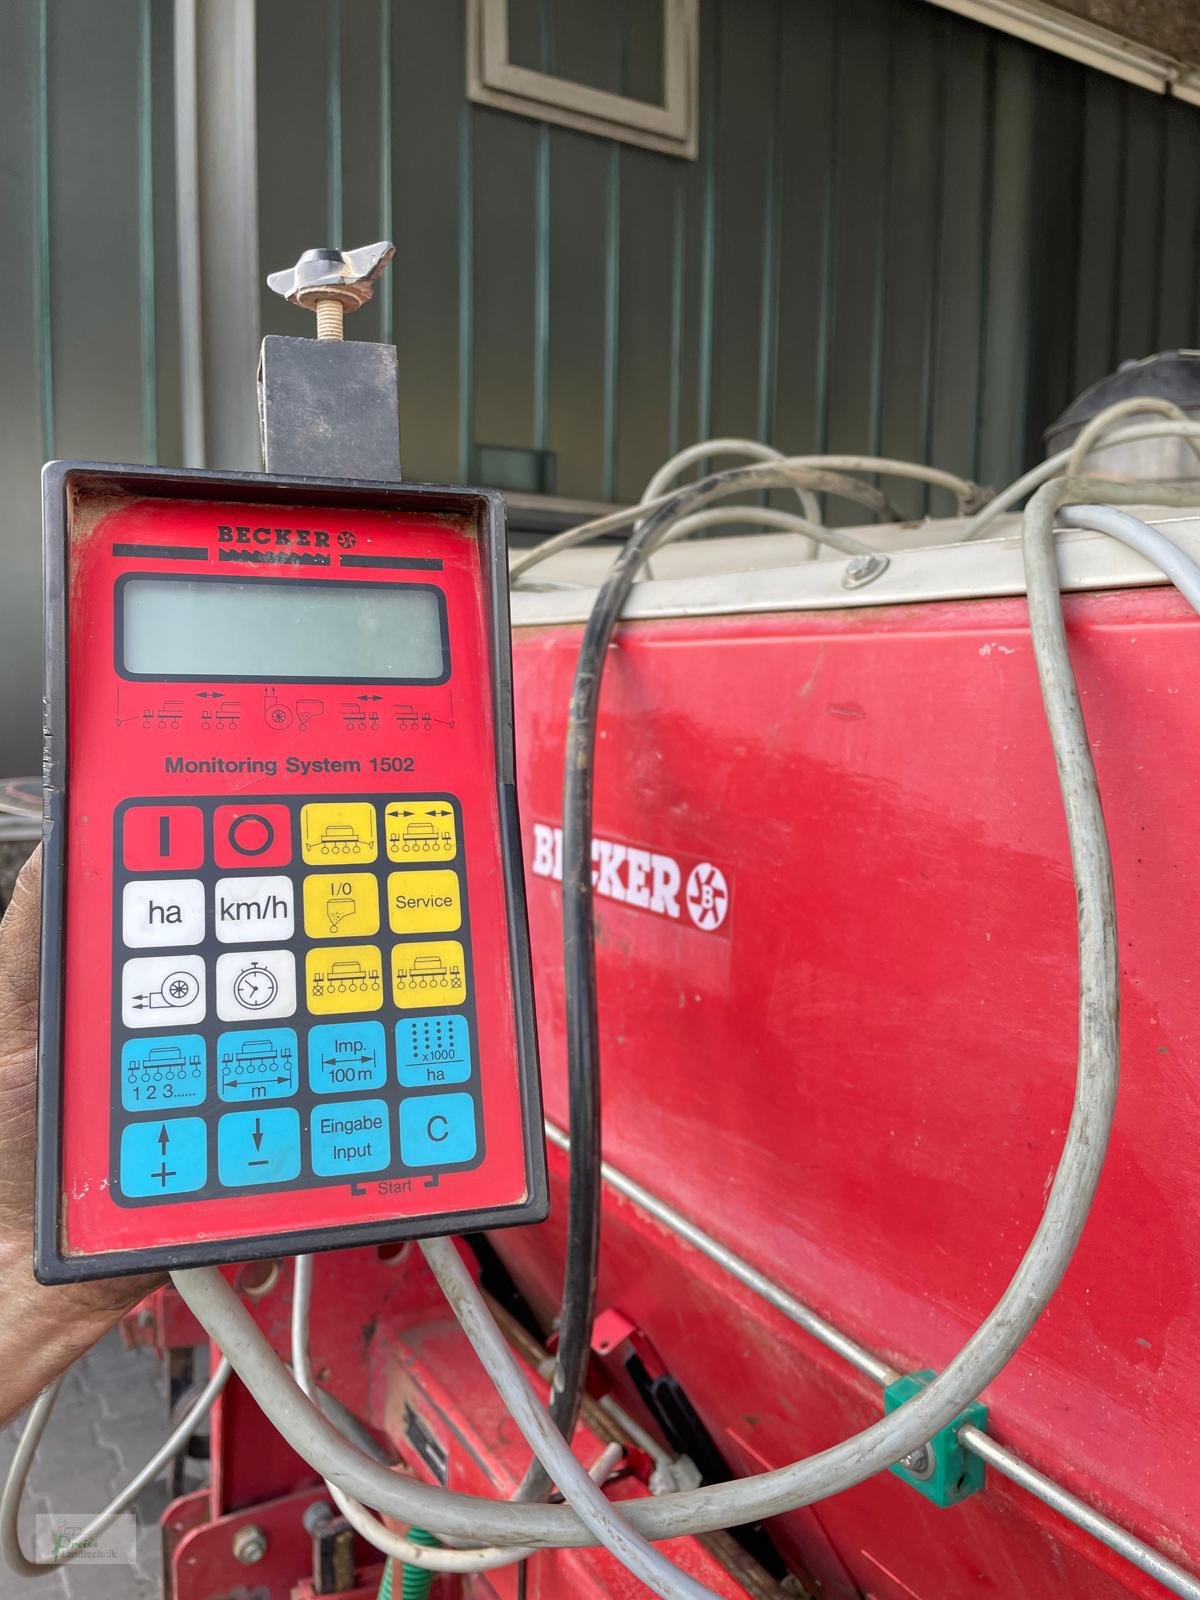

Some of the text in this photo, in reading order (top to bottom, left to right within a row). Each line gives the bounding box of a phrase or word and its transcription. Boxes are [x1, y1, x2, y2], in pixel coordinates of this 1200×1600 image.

[217, 526, 331, 548] BECKER
[165, 757, 415, 775] Monitoring System 1502
[532, 823, 681, 918] BKER
[220, 895, 288, 921] km/h
[395, 894, 453, 909] Service
[149, 900, 183, 925] ha
[334, 1039, 367, 1055] Imp.
[329, 1069, 356, 1083] 100
[427, 1068, 446, 1082] ha
[251, 1085, 267, 1098] m
[320, 1115, 384, 1134] Eingabe
[426, 1115, 450, 1142] C
[333, 1142, 373, 1162] Input
[378, 1180, 413, 1196] Start
